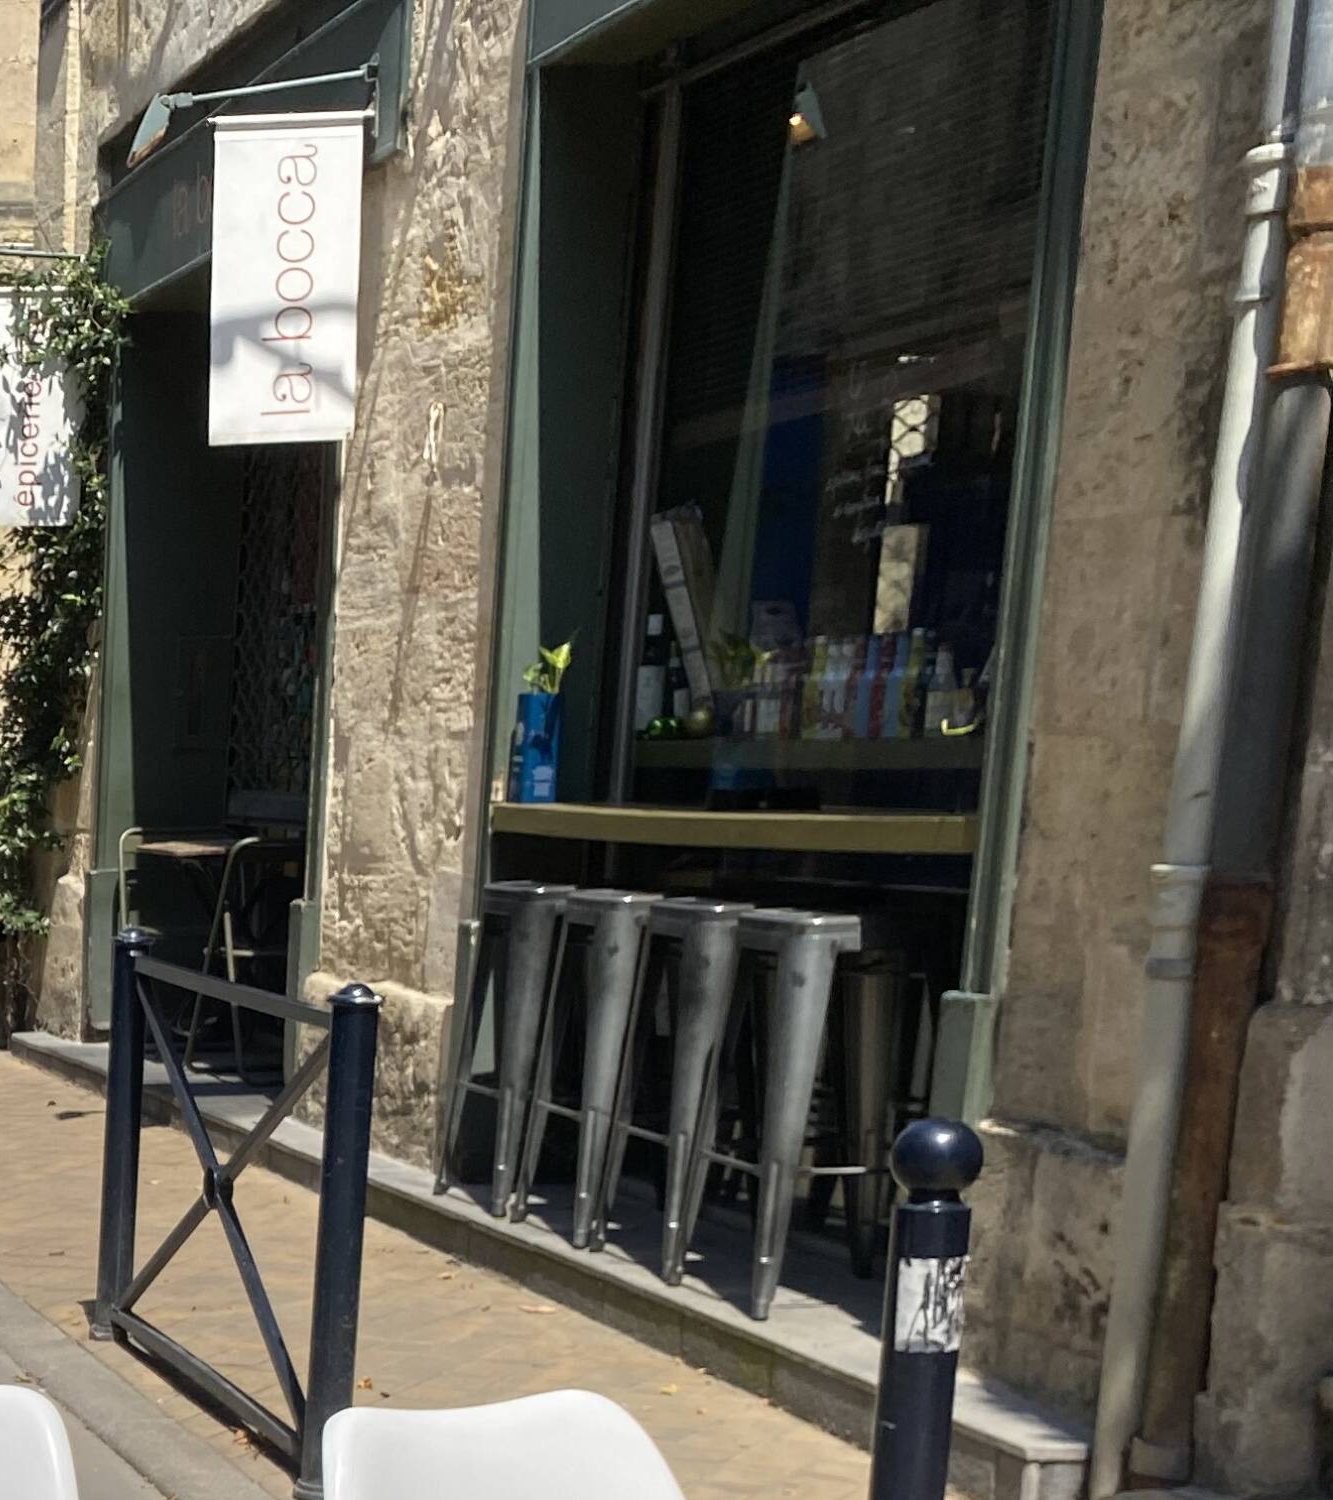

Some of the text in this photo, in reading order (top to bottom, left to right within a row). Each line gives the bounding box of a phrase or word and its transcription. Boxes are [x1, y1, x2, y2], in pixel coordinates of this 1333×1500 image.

[260, 143, 318, 417] la bocca
[13, 380, 43, 507] épicerie
